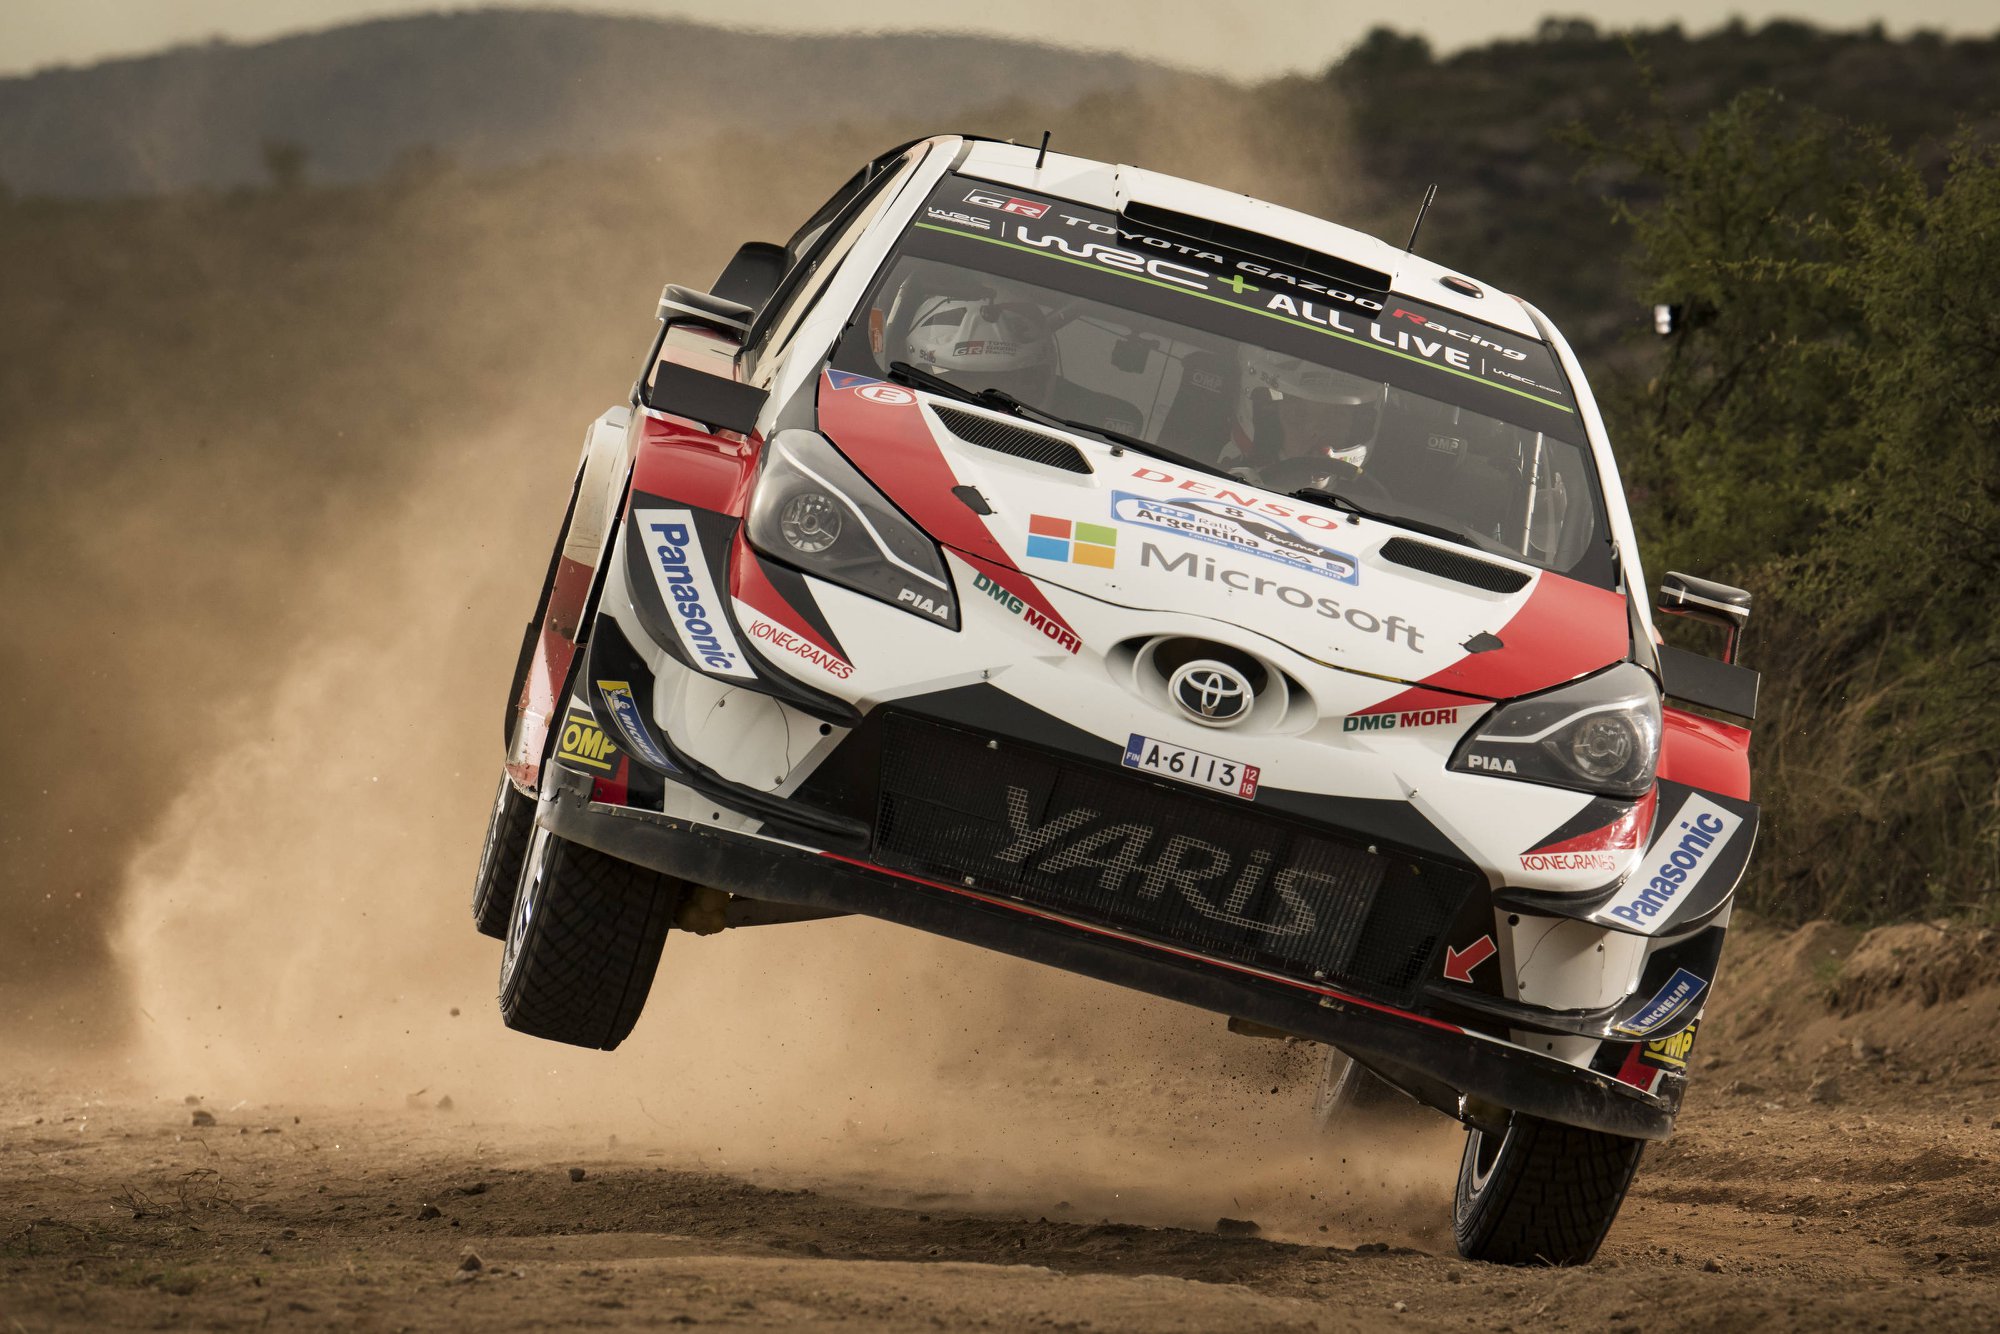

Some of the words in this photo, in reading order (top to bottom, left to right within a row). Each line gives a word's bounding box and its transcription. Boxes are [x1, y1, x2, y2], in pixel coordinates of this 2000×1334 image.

[928, 207, 991, 223] WRC
[968, 195, 1042, 218] GR
[1060, 214, 1223, 264] TOYOTA
[1236, 261, 1383, 312] GAZOO
[1392, 309, 1527, 361] Racing
[1266, 293, 1354, 333] ALL
[1370, 322, 1471, 370] LIVE
[954, 344, 985, 357] GR
[1428, 436, 1459, 450] OMP
[1131, 468, 1338, 530] DENSO
[1225, 507, 1245, 518] 8
[1136, 509, 1259, 548] Argentina
[1144, 503, 1190, 518] YPF
[1199, 517, 1237, 533] Rally
[650, 523, 736, 670] Panasonic
[897, 588, 950, 620] PIAA
[1140, 541, 1425, 654] Microsoft
[972, 571, 1024, 615] DMG
[1023, 607, 1083, 655] MORI
[748, 619, 854, 680] KONECRANES
[1342, 713, 1396, 732] DMG
[1400, 708, 1457, 728] MORI
[562, 723, 617, 761] OMP
[620, 712, 666, 767] MICHELIN
[1126, 752, 1140, 762] FIN
[1468, 754, 1517, 773] PIAA
[1242, 783, 1254, 795] 18
[1245, 768, 1257, 780] 12
[1519, 855, 1616, 872] KONECRANES
[1611, 812, 1724, 926] Panasonic
[1642, 980, 1691, 1026] MICHELIN
